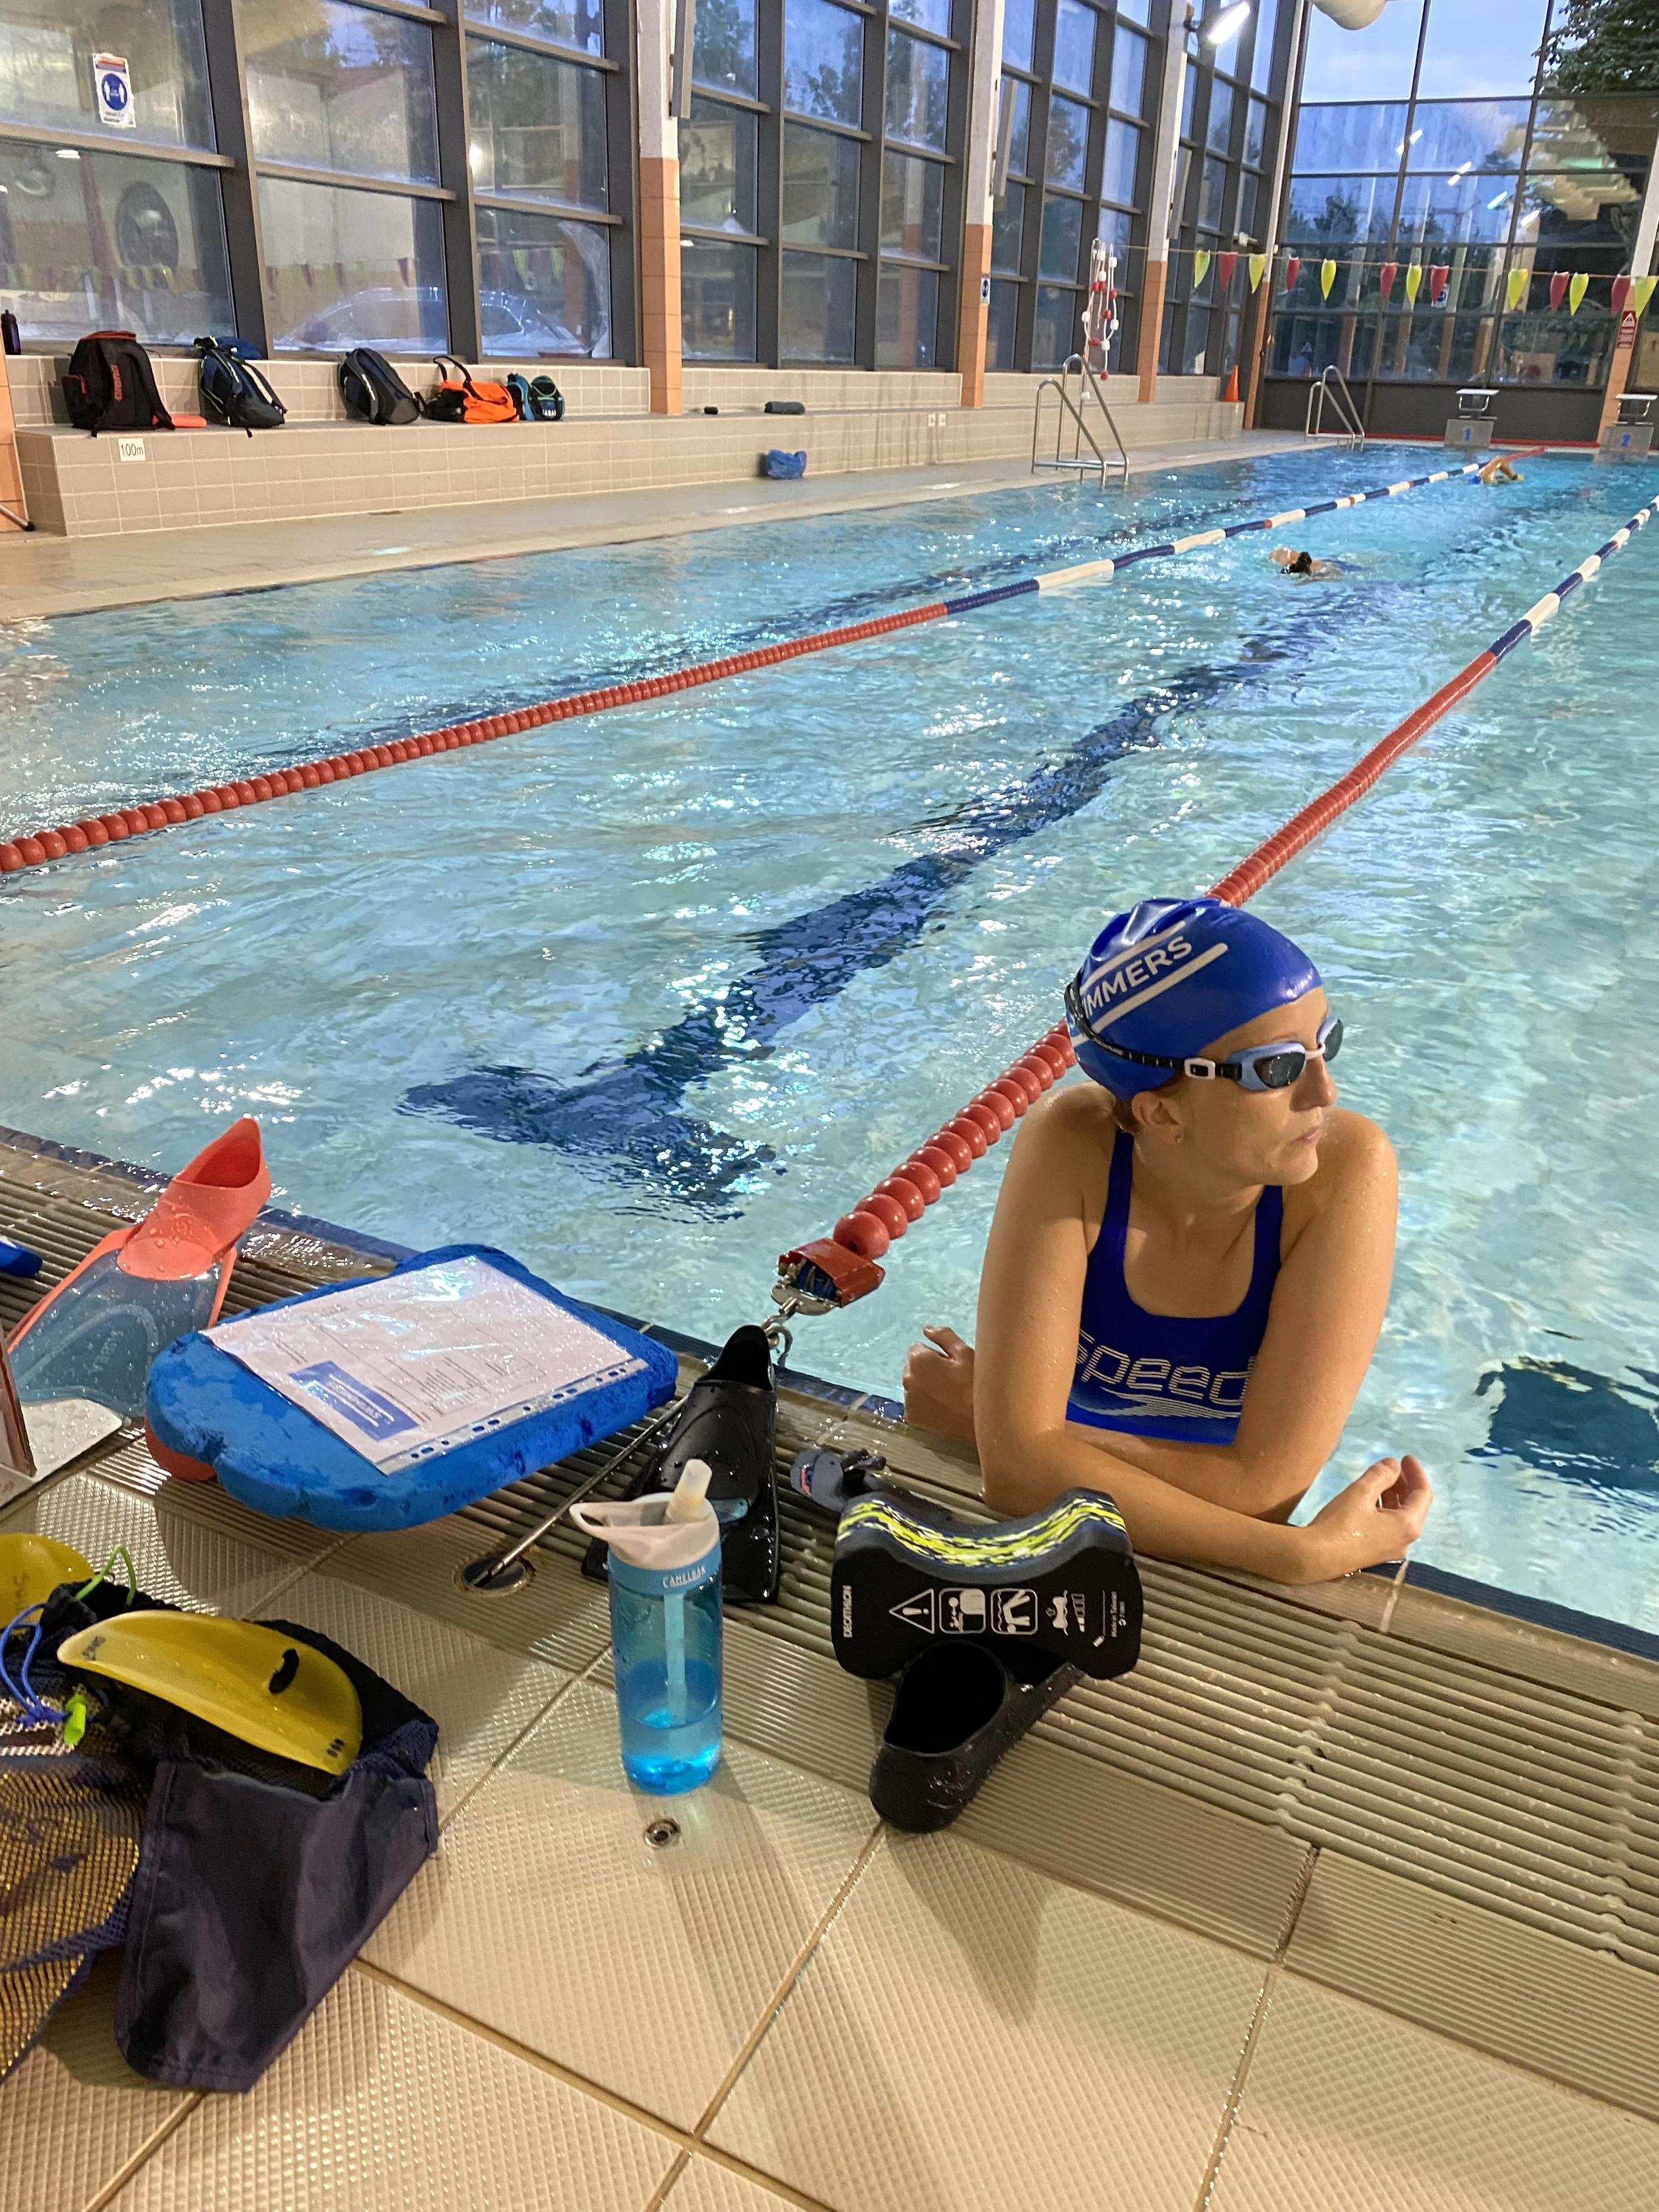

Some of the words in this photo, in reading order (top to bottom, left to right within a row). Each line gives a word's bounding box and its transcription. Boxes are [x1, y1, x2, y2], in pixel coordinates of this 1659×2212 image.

[121, 443, 144, 457] 100m
[1080, 936, 1192, 1021] IMMERS
[842, 1584, 853, 1639] DECATHLON
